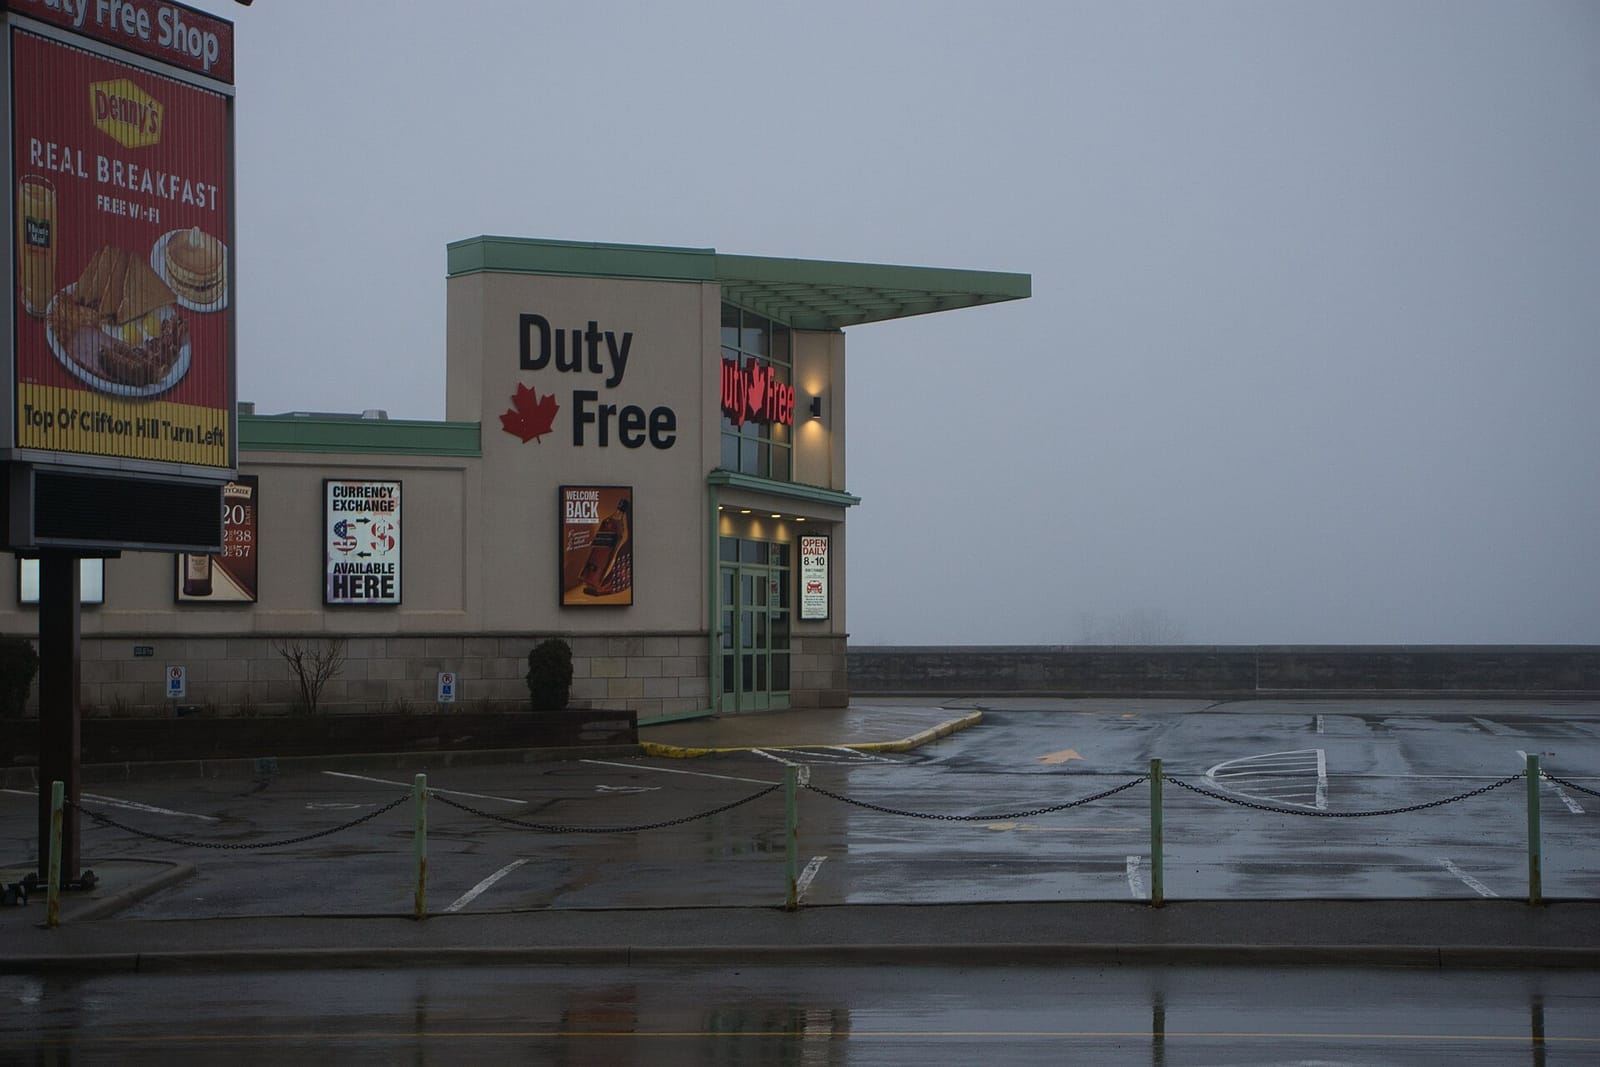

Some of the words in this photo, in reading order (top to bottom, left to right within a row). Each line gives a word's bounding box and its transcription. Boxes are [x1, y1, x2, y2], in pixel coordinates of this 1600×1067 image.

[97, 0, 150, 41] Free
[158, 7, 220, 72] Shop
[96, 88, 159, 136] Denny's
[30, 137, 89, 179] REAL
[97, 155, 218, 211] BREAKFAST
[97, 194, 127, 216] FREE
[129, 201, 160, 224] WI-FI
[519, 313, 633, 389] Duty
[766, 366, 795, 425] Free
[24, 404, 53, 434] Top
[58, 408, 78, 430] Of
[79, 411, 132, 436] Clifton
[136, 417, 159, 440] Hill
[162, 420, 194, 443] Turn
[197, 425, 225, 447] Left
[573, 390, 677, 449] Free
[332, 486, 394, 499] CURRENCY
[332, 499, 395, 512] EXCHANGE
[566, 490, 599, 501] WELCOME
[566, 501, 599, 518] BACK
[802, 538, 827, 547] OPEN
[802, 547, 827, 556] DAILY
[333, 563, 395, 575] AVAILABLE
[333, 576, 395, 599] HERE
